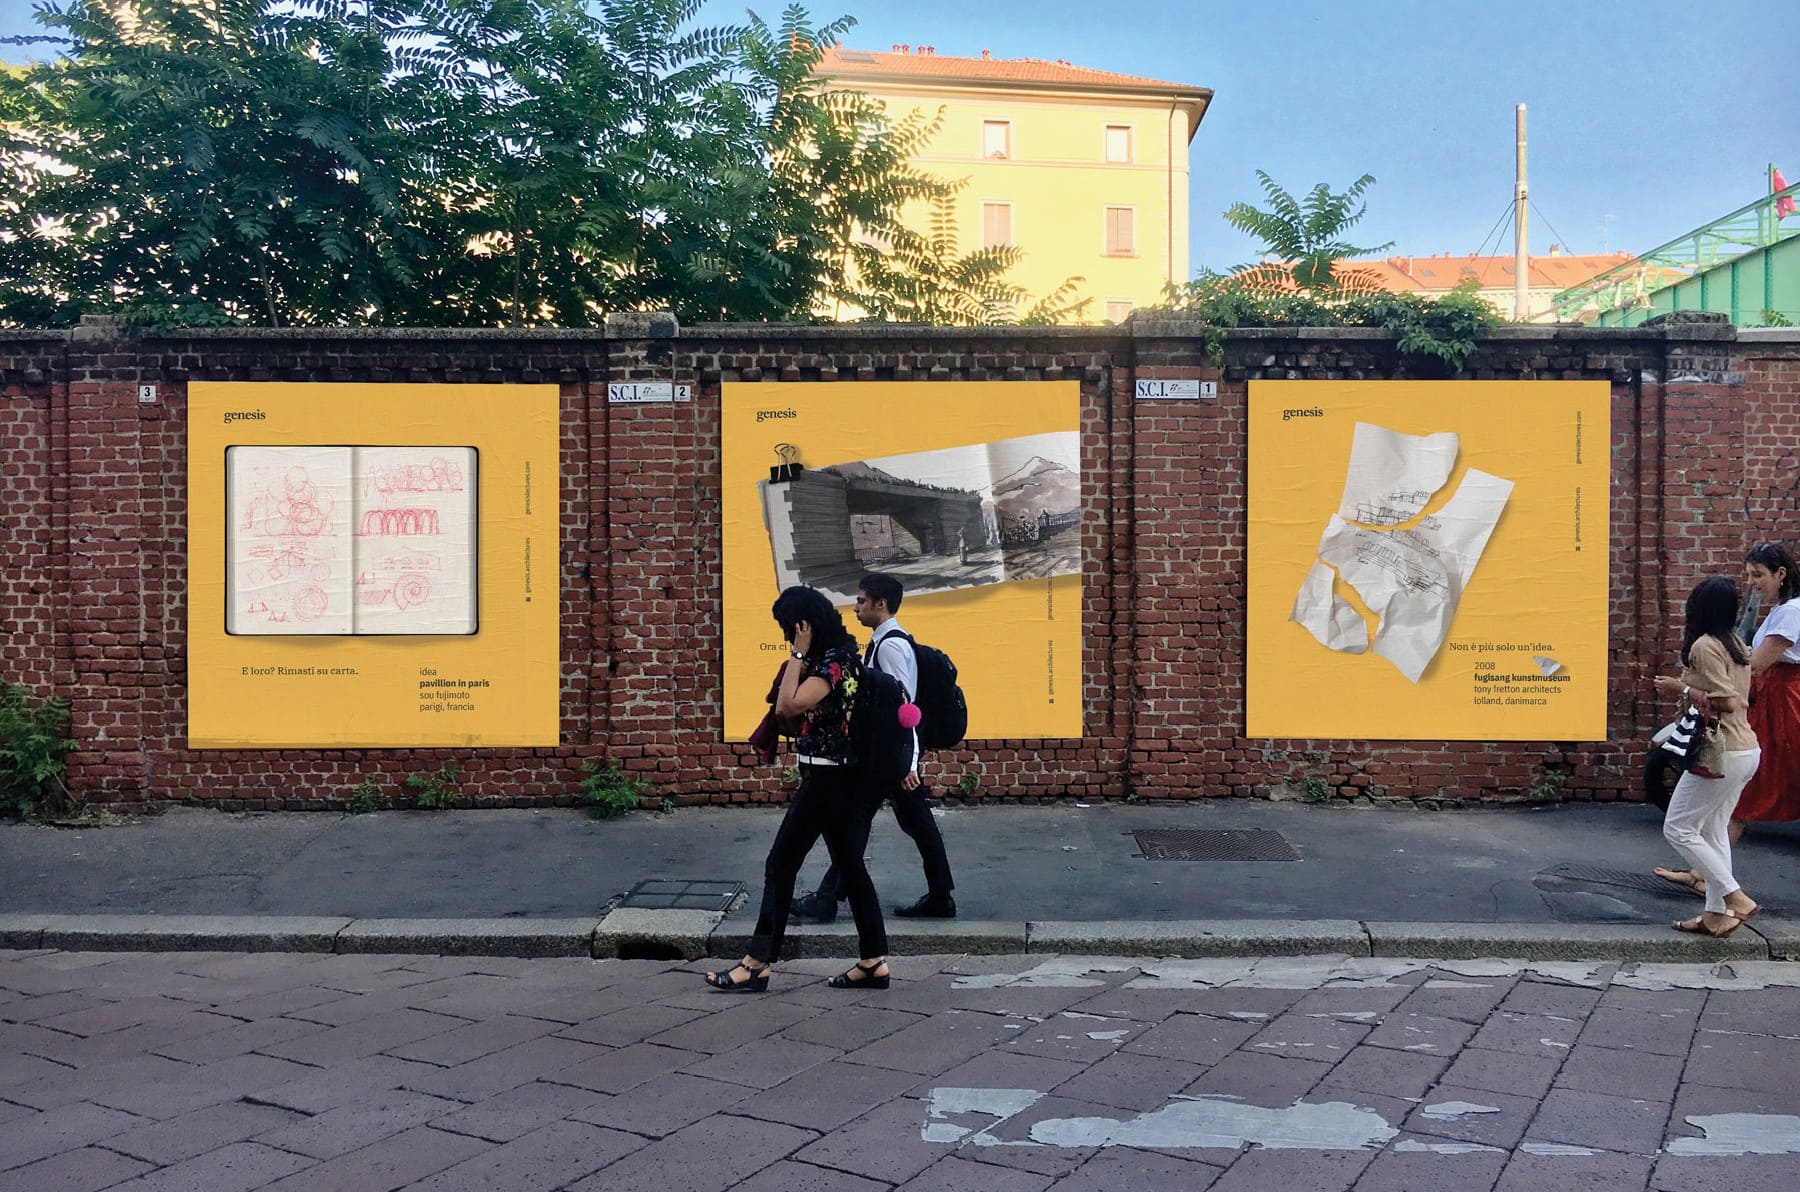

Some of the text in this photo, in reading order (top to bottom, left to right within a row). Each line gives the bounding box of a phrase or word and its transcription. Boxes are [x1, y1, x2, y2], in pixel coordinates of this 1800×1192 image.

[144, 386, 151, 397] 3
[610, 384, 641, 401] S.C.I.
[680, 386, 686, 397] 2
[1137, 381, 1168, 397] S.C.I.
[1206, 383, 1210, 393] 1
[223, 409, 266, 423] genesis
[756, 408, 797, 422] genesis
[1282, 406, 1324, 420] genesis
[760, 643, 777, 651] Ora
[779, 642, 787, 651] ci
[1449, 642, 1555, 653] Non è più solo un'idea.
[242, 667, 249, 675] E
[251, 667, 276, 675] loro?
[278, 666, 315, 675] Rimasti
[1474, 662, 1496, 670] 2008
[420, 667, 437, 676] idea
[1474, 673, 1571, 683] fuglsang kunstmuseum
[420, 679, 490, 689] pavillion in paris
[1474, 684, 1562, 695] tony fretton architects
[436, 691, 470, 701] fujimoto
[1505, 696, 1547, 705] danimarca
[420, 703, 475, 712] parigi, francia
